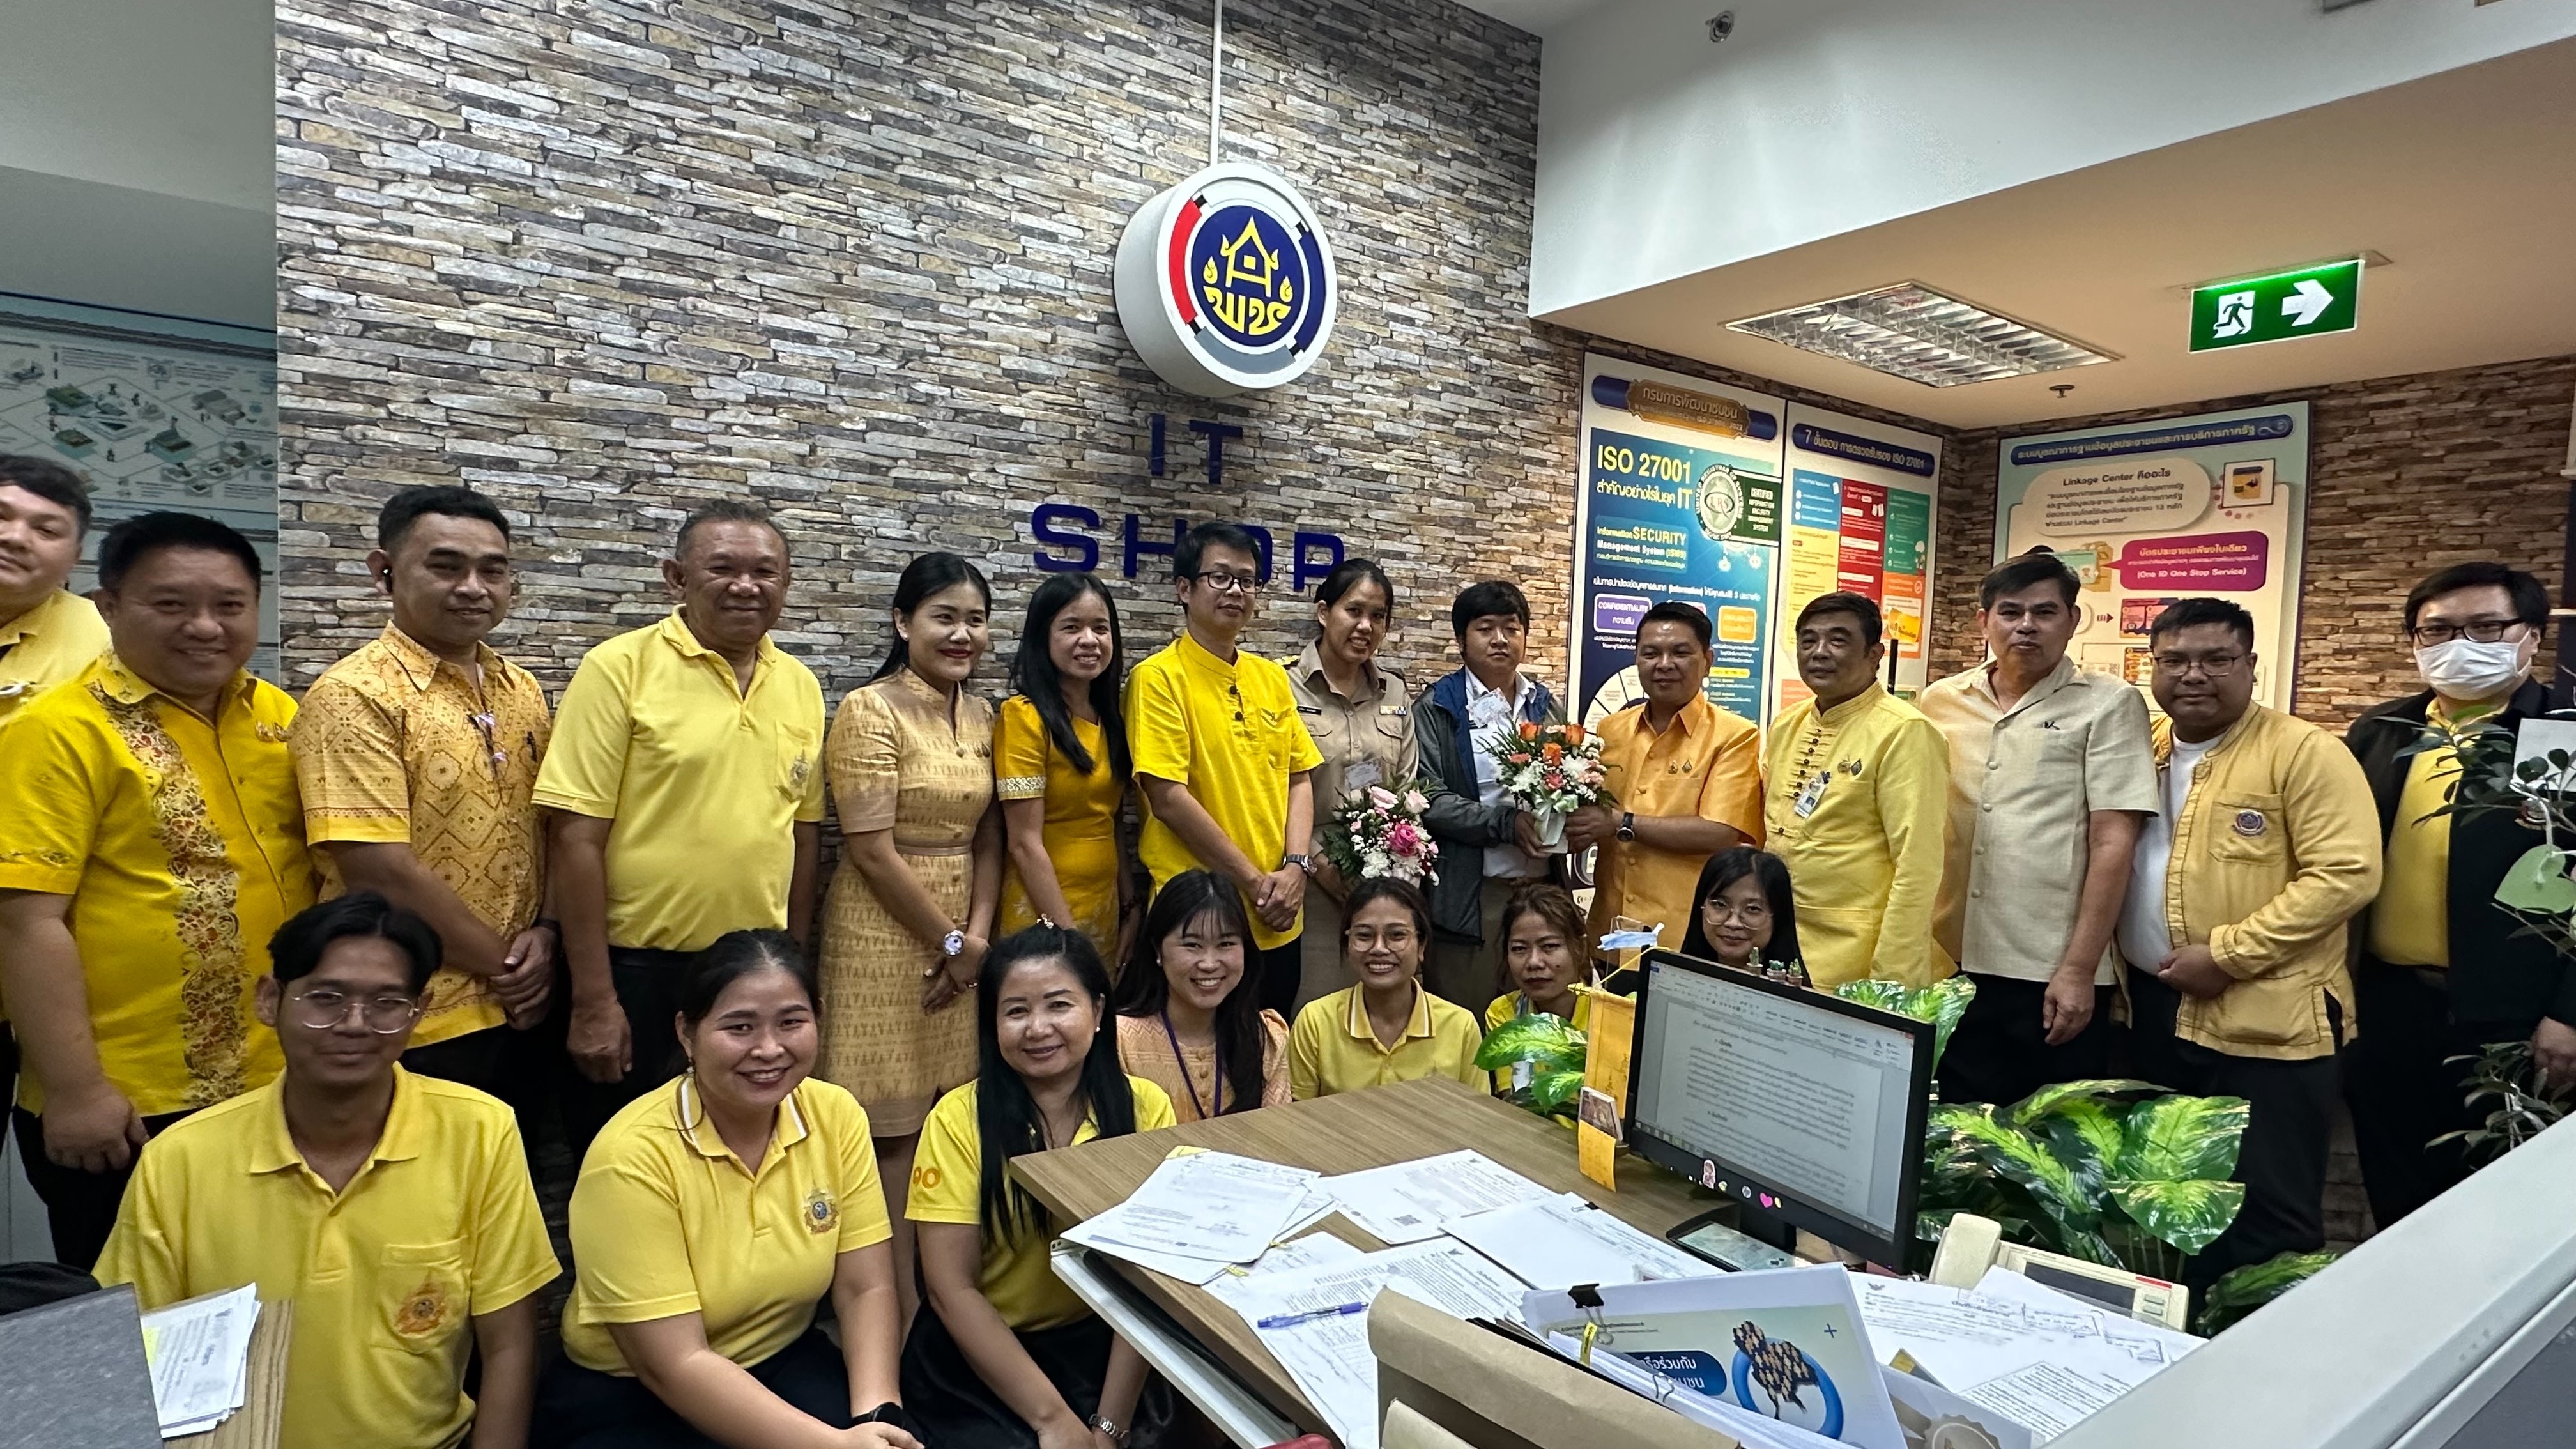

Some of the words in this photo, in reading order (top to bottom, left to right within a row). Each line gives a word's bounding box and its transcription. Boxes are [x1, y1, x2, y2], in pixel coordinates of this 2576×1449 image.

[1151, 413, 1243, 484] IT
[1805, 429, 1812, 444] 7
[1813, 431, 1839, 449] ขั้นตอน
[1892, 453, 1905, 464] ISO
[1906, 456, 1924, 469] 27001
[1597, 445, 1634, 474] ISO
[1639, 453, 1690, 484] 27001
[2063, 477, 2098, 486] Linkage
[2102, 473, 2133, 482] Center
[2137, 468, 2171, 480] คืออะไร
[1677, 487, 1693, 509] IT
[1633, 526, 1687, 546] SECURITY
[1597, 540, 1640, 553] Management
[1642, 545, 1665, 556] System
[2190, 569, 2210, 577] Stop
[2212, 567, 2246, 576] Service)
